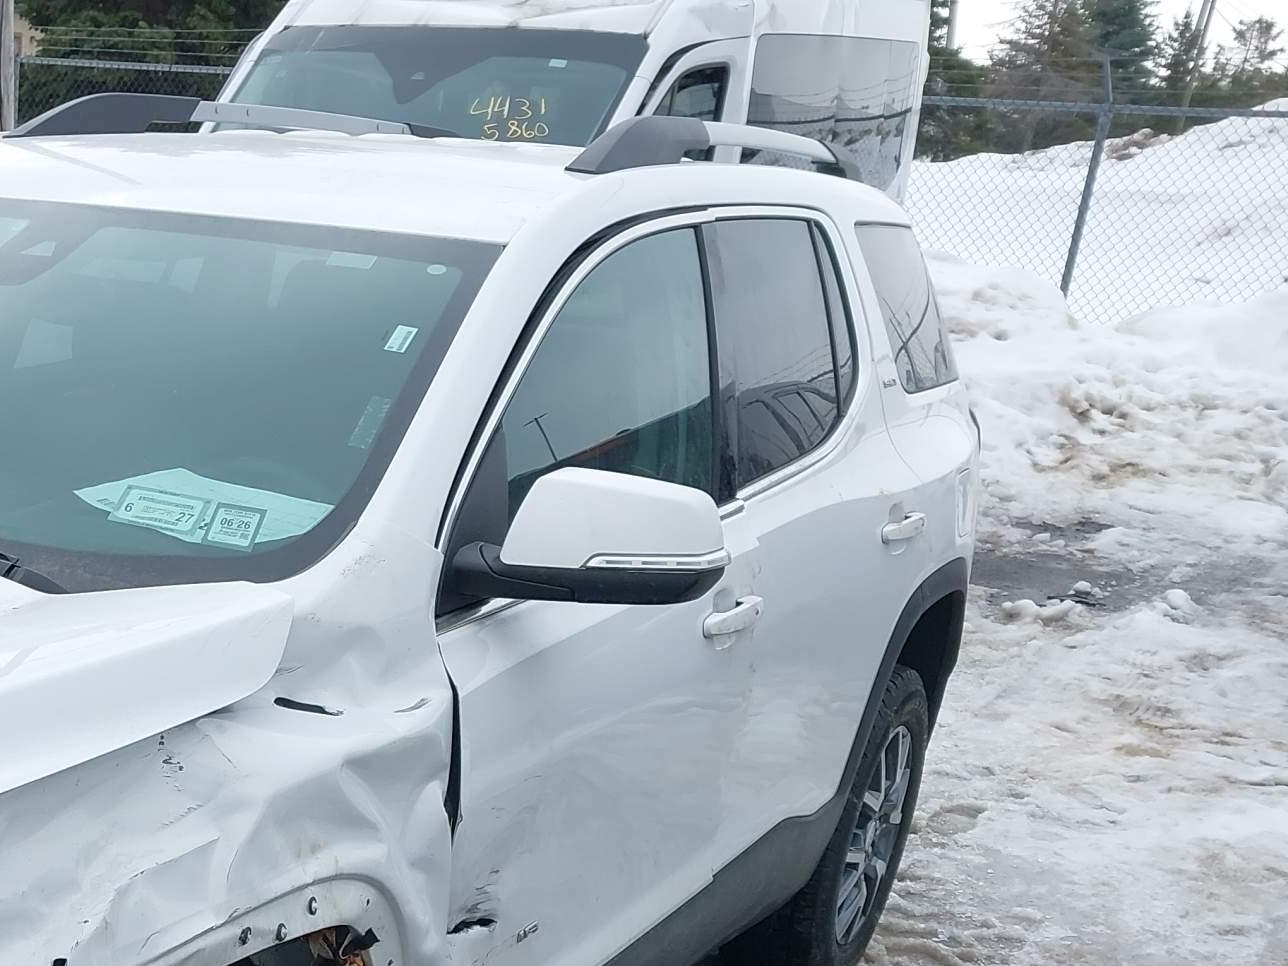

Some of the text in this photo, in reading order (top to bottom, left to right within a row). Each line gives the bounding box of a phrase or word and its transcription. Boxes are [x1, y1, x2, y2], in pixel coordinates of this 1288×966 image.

[469, 96, 546, 120] 4431
[124, 502, 135, 513] 6
[175, 511, 196, 524] 27
[219, 517, 235, 527] 06
[236, 519, 251, 530] 26
